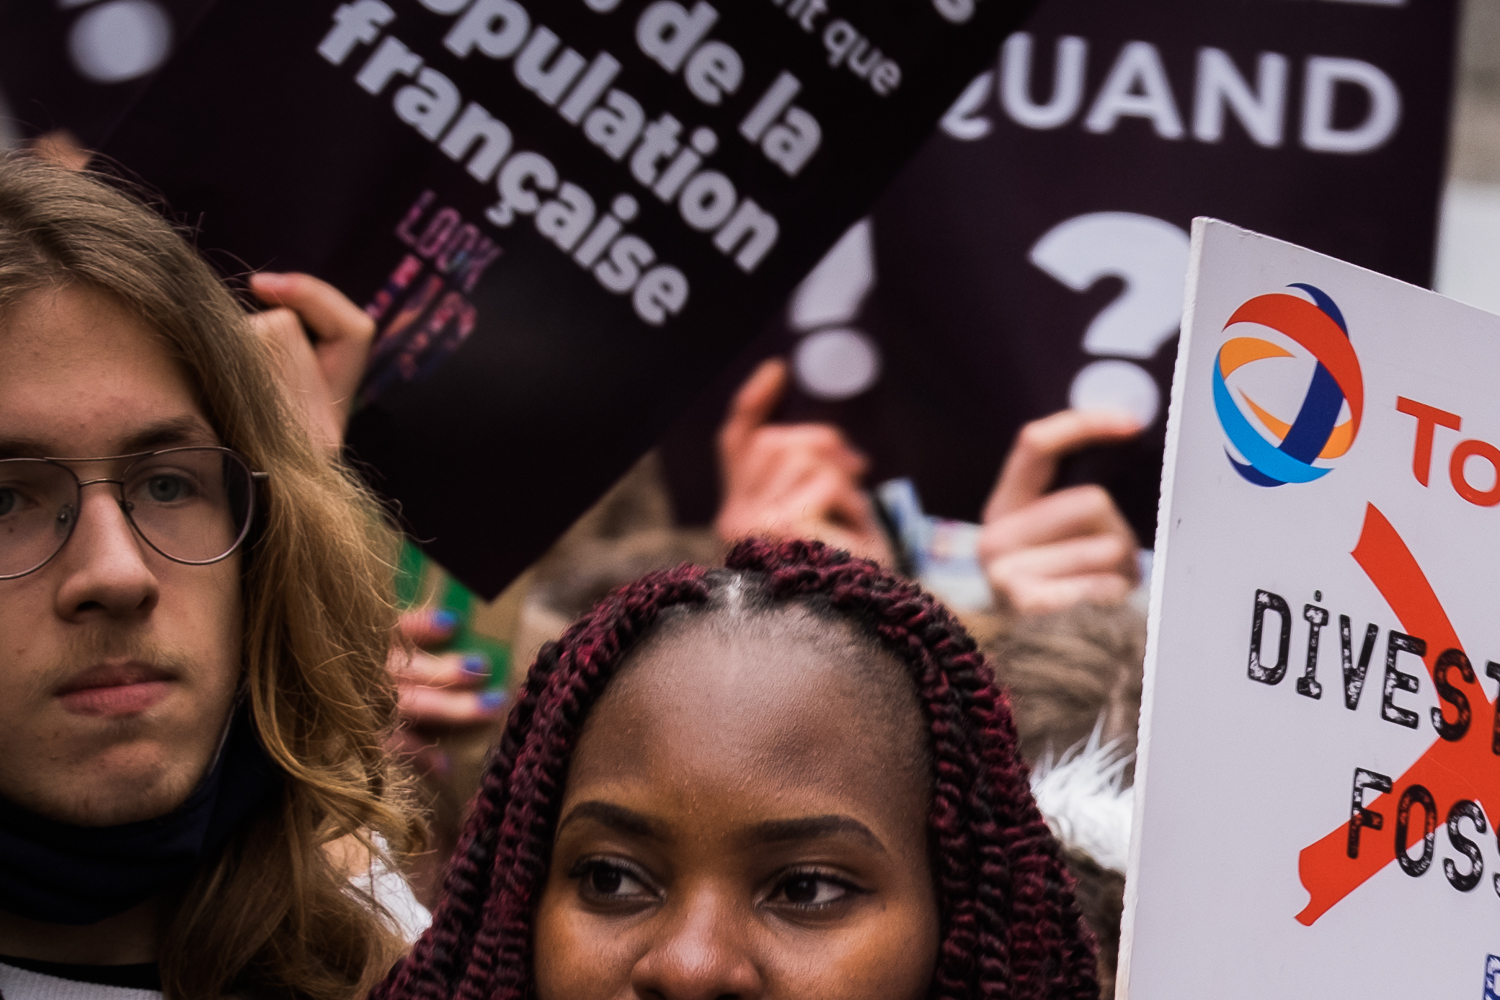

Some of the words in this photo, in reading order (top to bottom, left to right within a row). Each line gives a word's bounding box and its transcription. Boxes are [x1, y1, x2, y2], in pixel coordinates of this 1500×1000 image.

[317, 0, 690, 325] française
[416, 0, 780, 273] pulation
[635, 0, 745, 106] de
[738, 70, 823, 178] la
[823, 18, 902, 96] que
